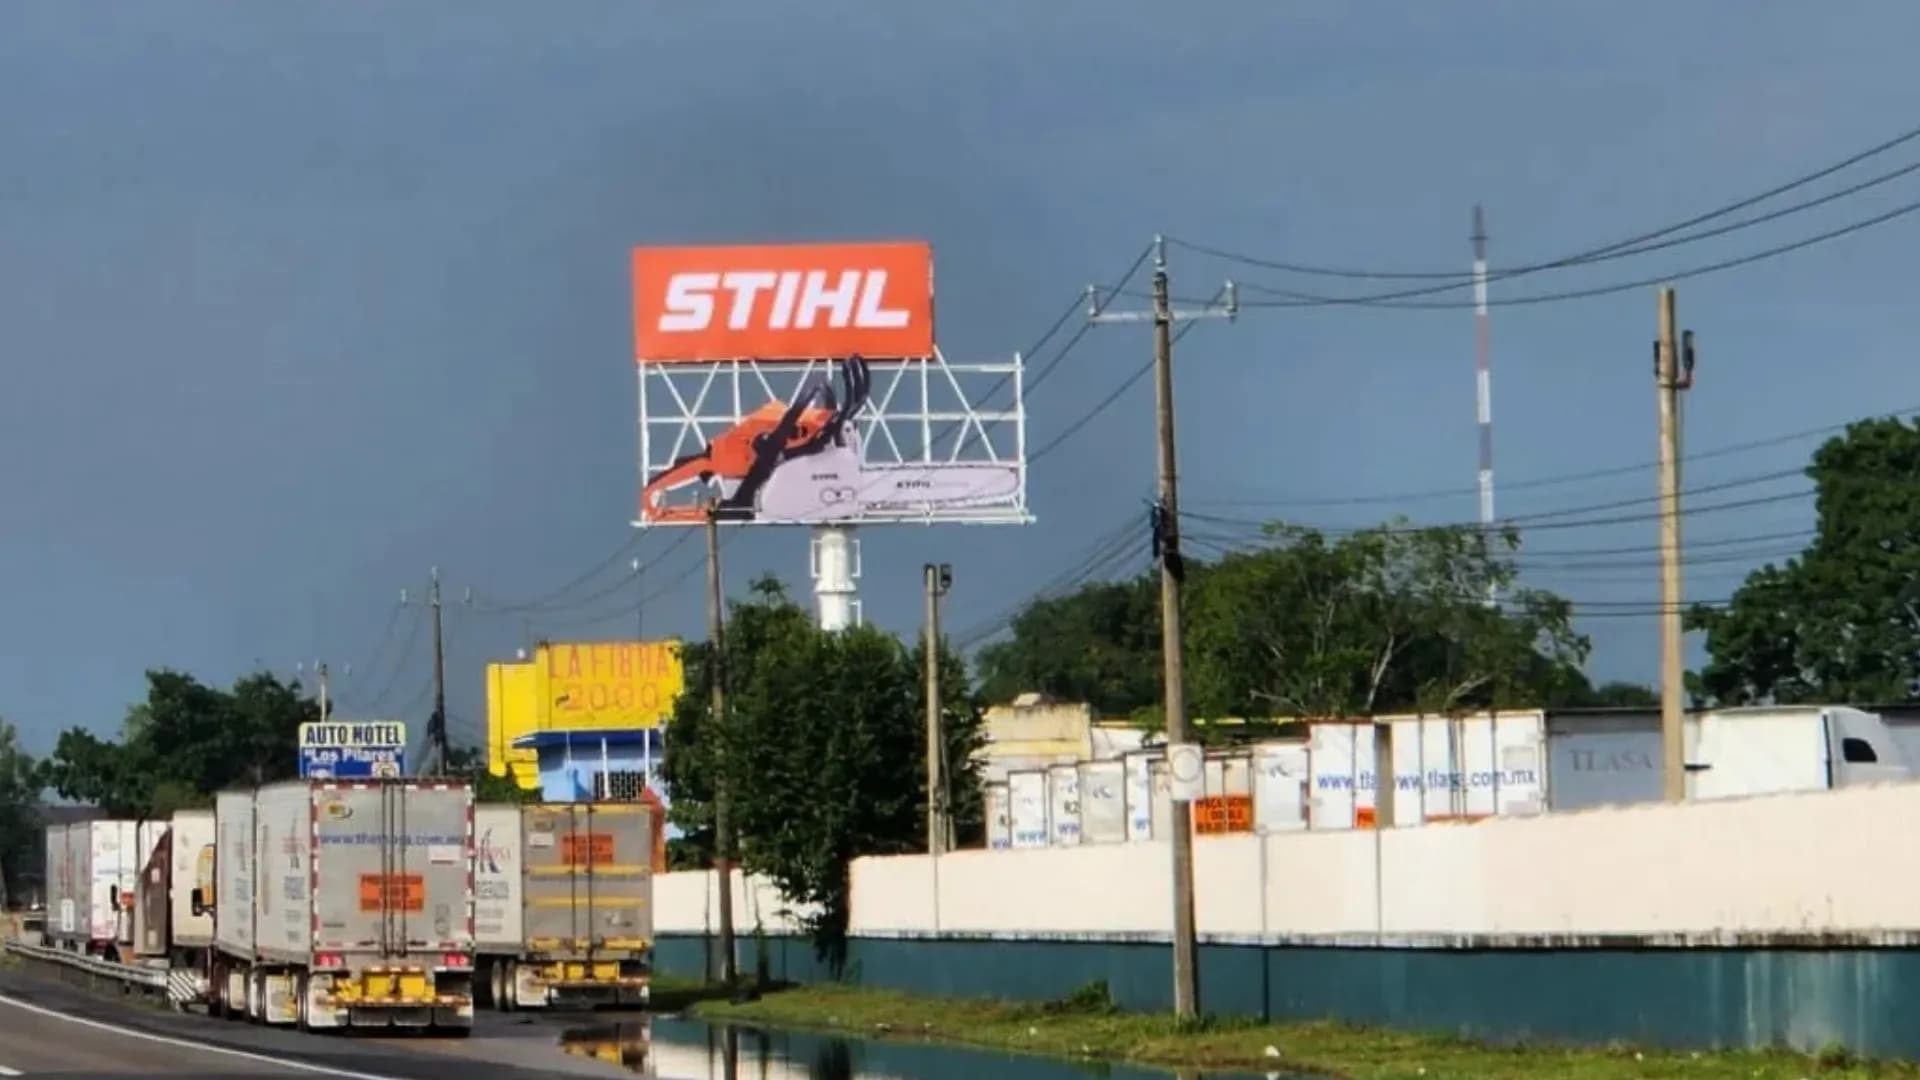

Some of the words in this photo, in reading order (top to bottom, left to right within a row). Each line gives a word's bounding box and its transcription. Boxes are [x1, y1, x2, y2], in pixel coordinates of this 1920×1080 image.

[658, 269, 910, 331] STIHL
[549, 644, 582, 679] LA
[305, 725, 347, 744] AUTO
[1568, 748, 1653, 773] TLASA
